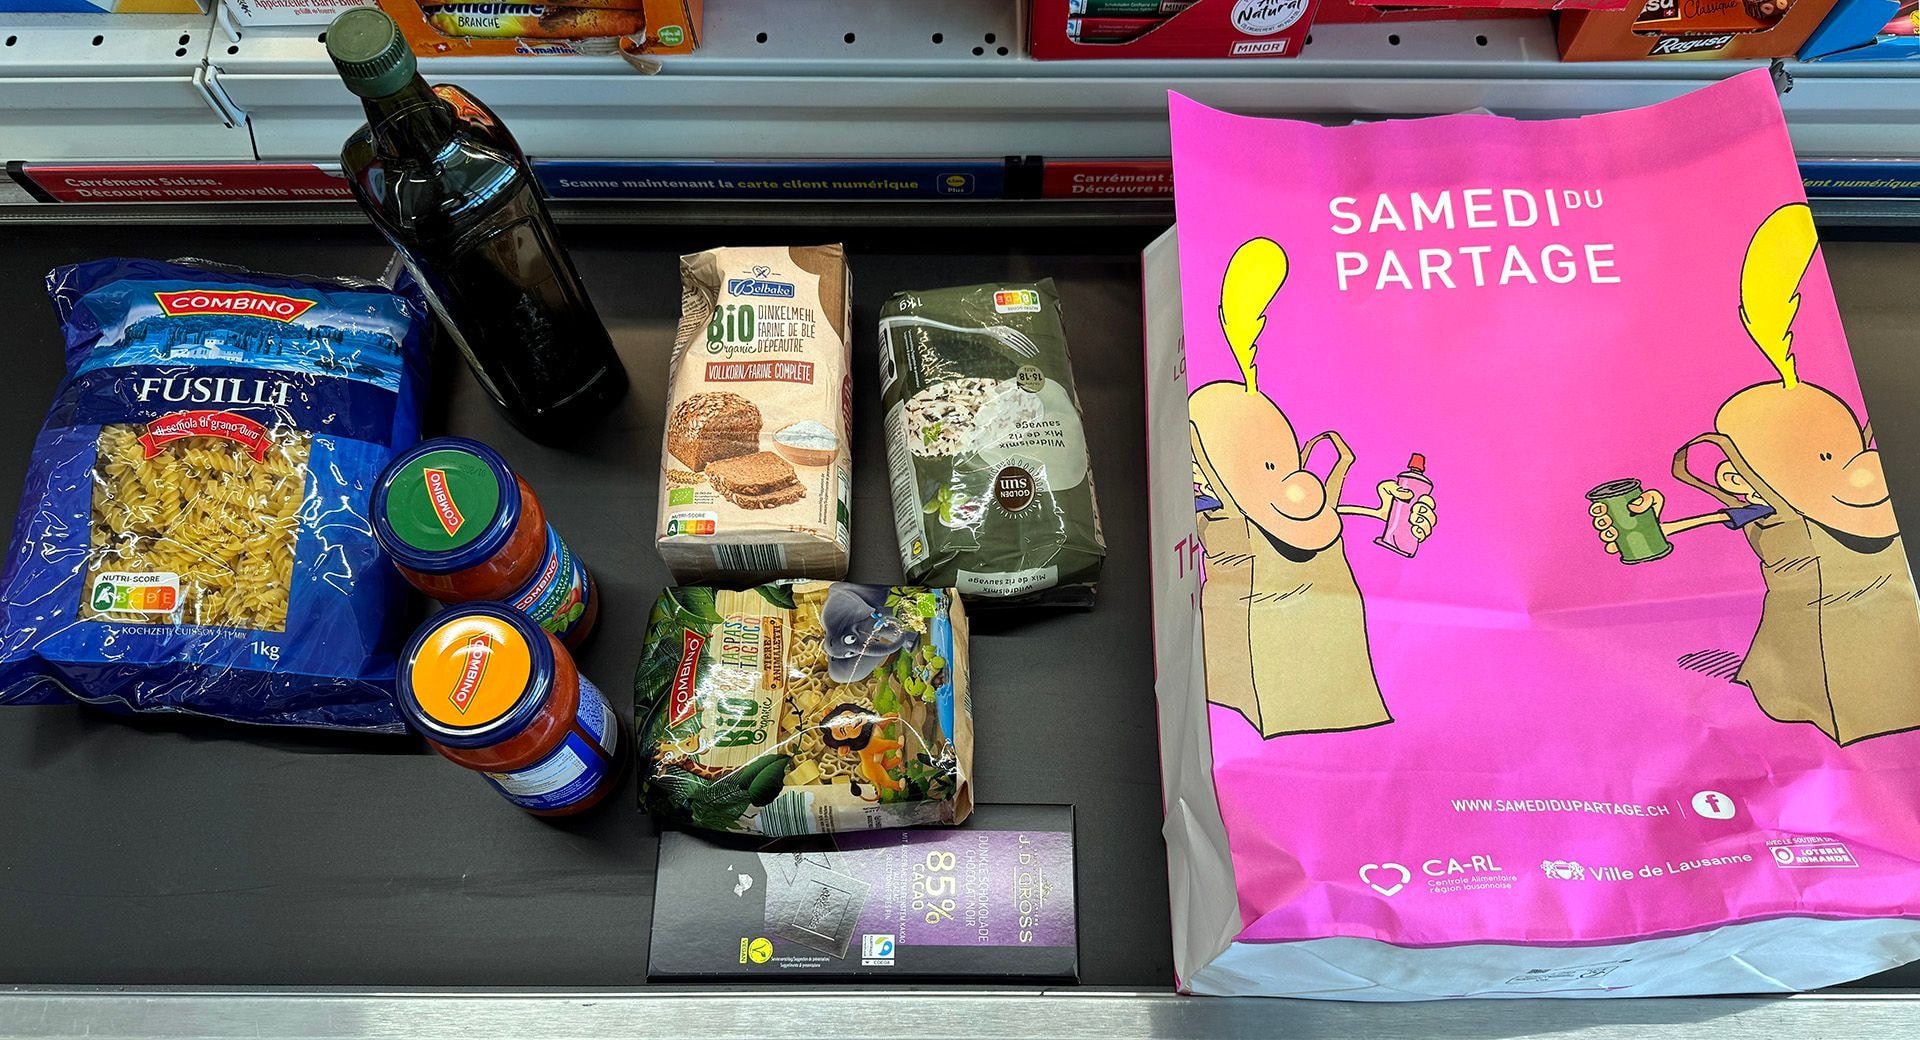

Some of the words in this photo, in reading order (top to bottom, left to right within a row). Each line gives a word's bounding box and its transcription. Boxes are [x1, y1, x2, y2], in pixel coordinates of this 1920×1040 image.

[1237, 0, 1301, 24] Natural
[1684, 0, 1737, 19] Classique
[458, 16, 500, 28] BRANCHE
[1237, 43, 1280, 52] MINOR
[1652, 35, 1732, 54] Ragusa
[65, 177, 158, 187] Carrément
[159, 176, 223, 186] Suisse.
[560, 179, 619, 188] Scanne
[622, 179, 715, 189] maintenant
[719, 179, 733, 189] la
[737, 181, 778, 189] carte
[782, 179, 829, 189] client
[831, 178, 919, 192] numérique
[1073, 174, 1165, 183] Carrément
[1832, 178, 1920, 189] numérique
[77, 188, 162, 198] Découvre
[167, 189, 209, 198] notre
[211, 188, 288, 197] nouvelle
[1072, 185, 1154, 194] Découvre
[1329, 188, 1561, 235] SAMEDI
[1563, 189, 1604, 209] DU
[1335, 244, 1622, 291] PARTAGE
[734, 279, 791, 296] Belbake
[171, 297, 295, 315] COMBINO
[758, 304, 816, 323] DINKELMEHL
[758, 322, 785, 338] FARINE
[789, 323, 798, 337] DE
[802, 322, 816, 339] BLÉ
[757, 337, 804, 353] D'ÉPEAUTRE
[709, 362, 773, 380] VOLLKORN/FARINE
[774, 362, 811, 382] COMPLÈTE
[139, 377, 292, 407] FUSILLI
[156, 425, 164, 435] di
[166, 418, 197, 432] semola
[200, 416, 209, 427] di
[211, 420, 238, 432] grano
[239, 424, 258, 440] duro
[1015, 420, 1061, 429] sauvage
[1045, 430, 1064, 438] Mix
[999, 439, 1065, 449] Wildreismix
[1000, 478, 1027, 490] sun
[430, 473, 459, 526] COMBINO
[1000, 489, 1030, 498] GOLDEN
[668, 523, 677, 532] A
[102, 575, 161, 583] NUTRI-SCORE
[516, 559, 557, 610] COMBINO
[968, 578, 1004, 586] sauvage
[95, 587, 111, 604] A
[122, 626, 215, 637] KOCHZEIT/CUISSON
[251, 641, 280, 660] 1kg
[763, 635, 772, 671] TIERE/
[773, 624, 782, 682] ANIMALETTI
[456, 639, 485, 703] COMBINO
[677, 639, 701, 715] COMBINO
[1451, 799, 1670, 818] WWW.SAMEDIDUPARTAGE.CH
[1795, 854, 1851, 864] ROMANDE
[1801, 847, 1847, 856] LOTERIE
[965, 849, 976, 900] CHOCOLAT
[1421, 854, 1503, 877] CA-RL
[1588, 866, 1635, 882] Ville
[1639, 864, 1664, 879] de
[1666, 852, 1754, 875] Lausanne
[912, 863, 924, 910] CACAO
[925, 850, 956, 925] 85%
[1427, 877, 1469, 887] Centrale
[1471, 874, 1518, 882] Alimentaire
[1429, 885, 1462, 895] région
[1464, 882, 1512, 891] lausannoise
[965, 902, 976, 927] NOIR
[978, 876, 989, 942] SCHOKOLADE
[1018, 872, 1033, 943] GROSS
